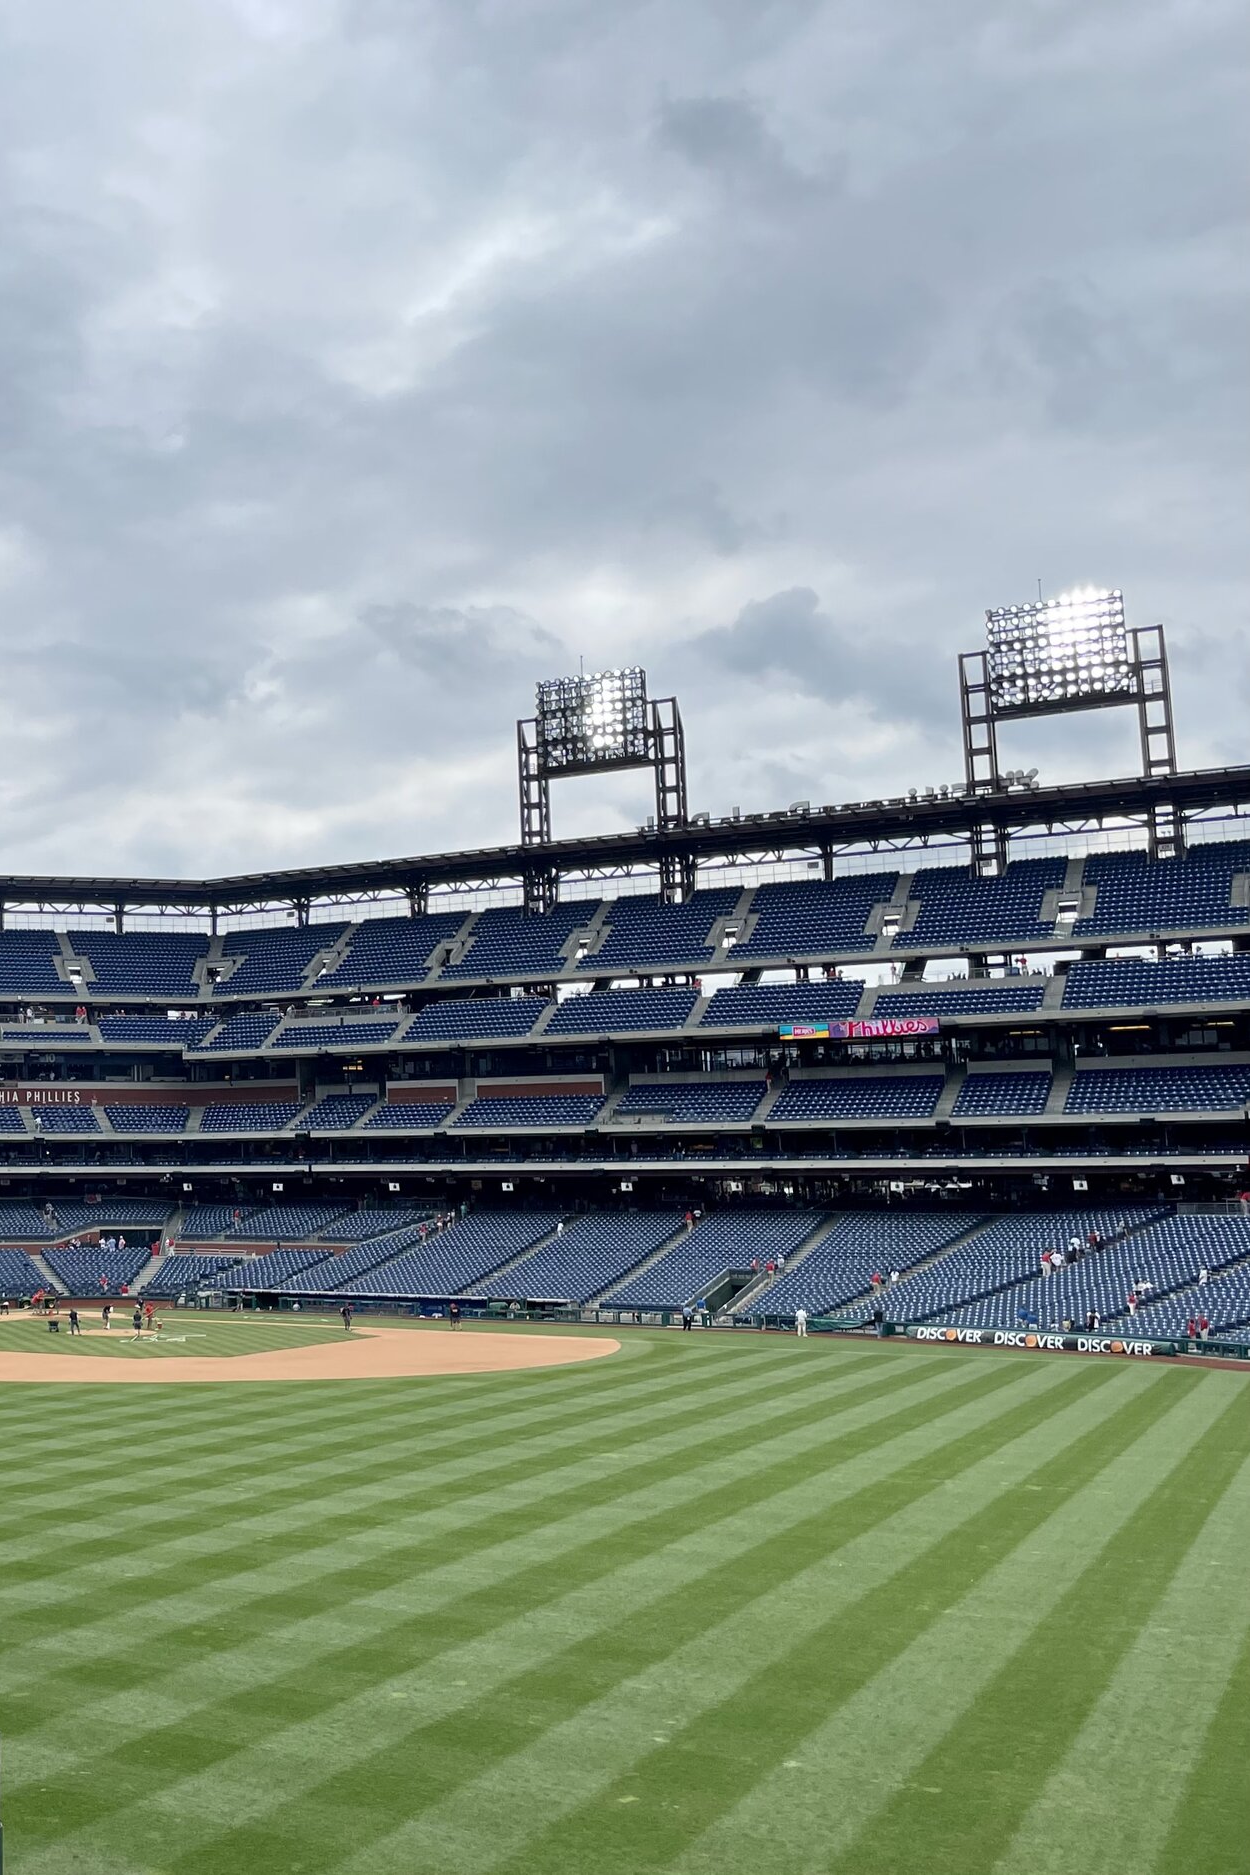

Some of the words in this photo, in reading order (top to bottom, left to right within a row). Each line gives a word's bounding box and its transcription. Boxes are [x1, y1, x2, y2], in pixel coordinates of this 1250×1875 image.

[840, 1018, 928, 1037] Phillies
[26, 1090, 80, 1102] PHILLIES
[916, 1327, 982, 1343] DISCOVER
[994, 1331, 1064, 1350] DISCOVER
[1077, 1338, 1152, 1355] DISCOVER
